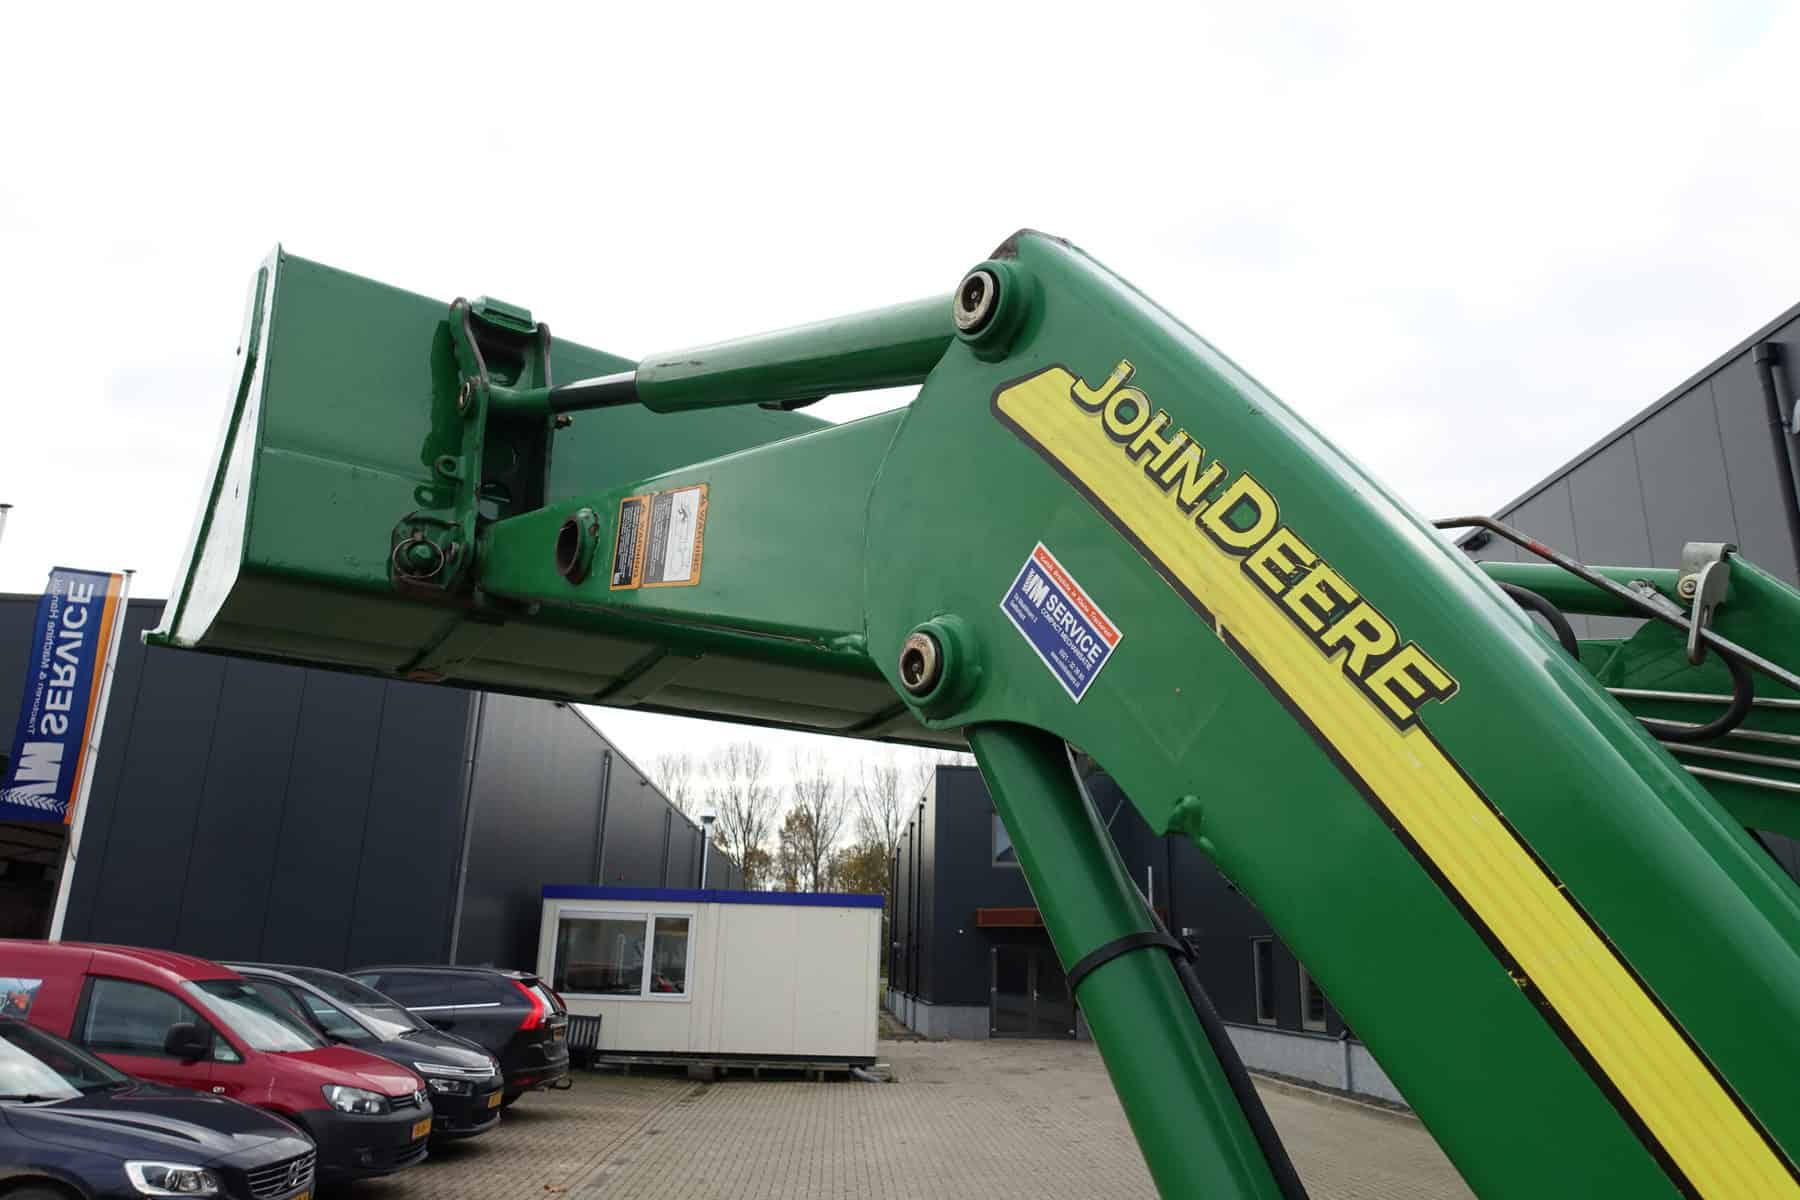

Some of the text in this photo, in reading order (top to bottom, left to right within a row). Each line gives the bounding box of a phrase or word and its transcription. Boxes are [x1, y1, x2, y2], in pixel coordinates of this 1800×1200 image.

[1045, 594, 1102, 664] SERVICE
[1071, 359, 1228, 515] JOHN
[1196, 472, 1459, 731] DEERE
